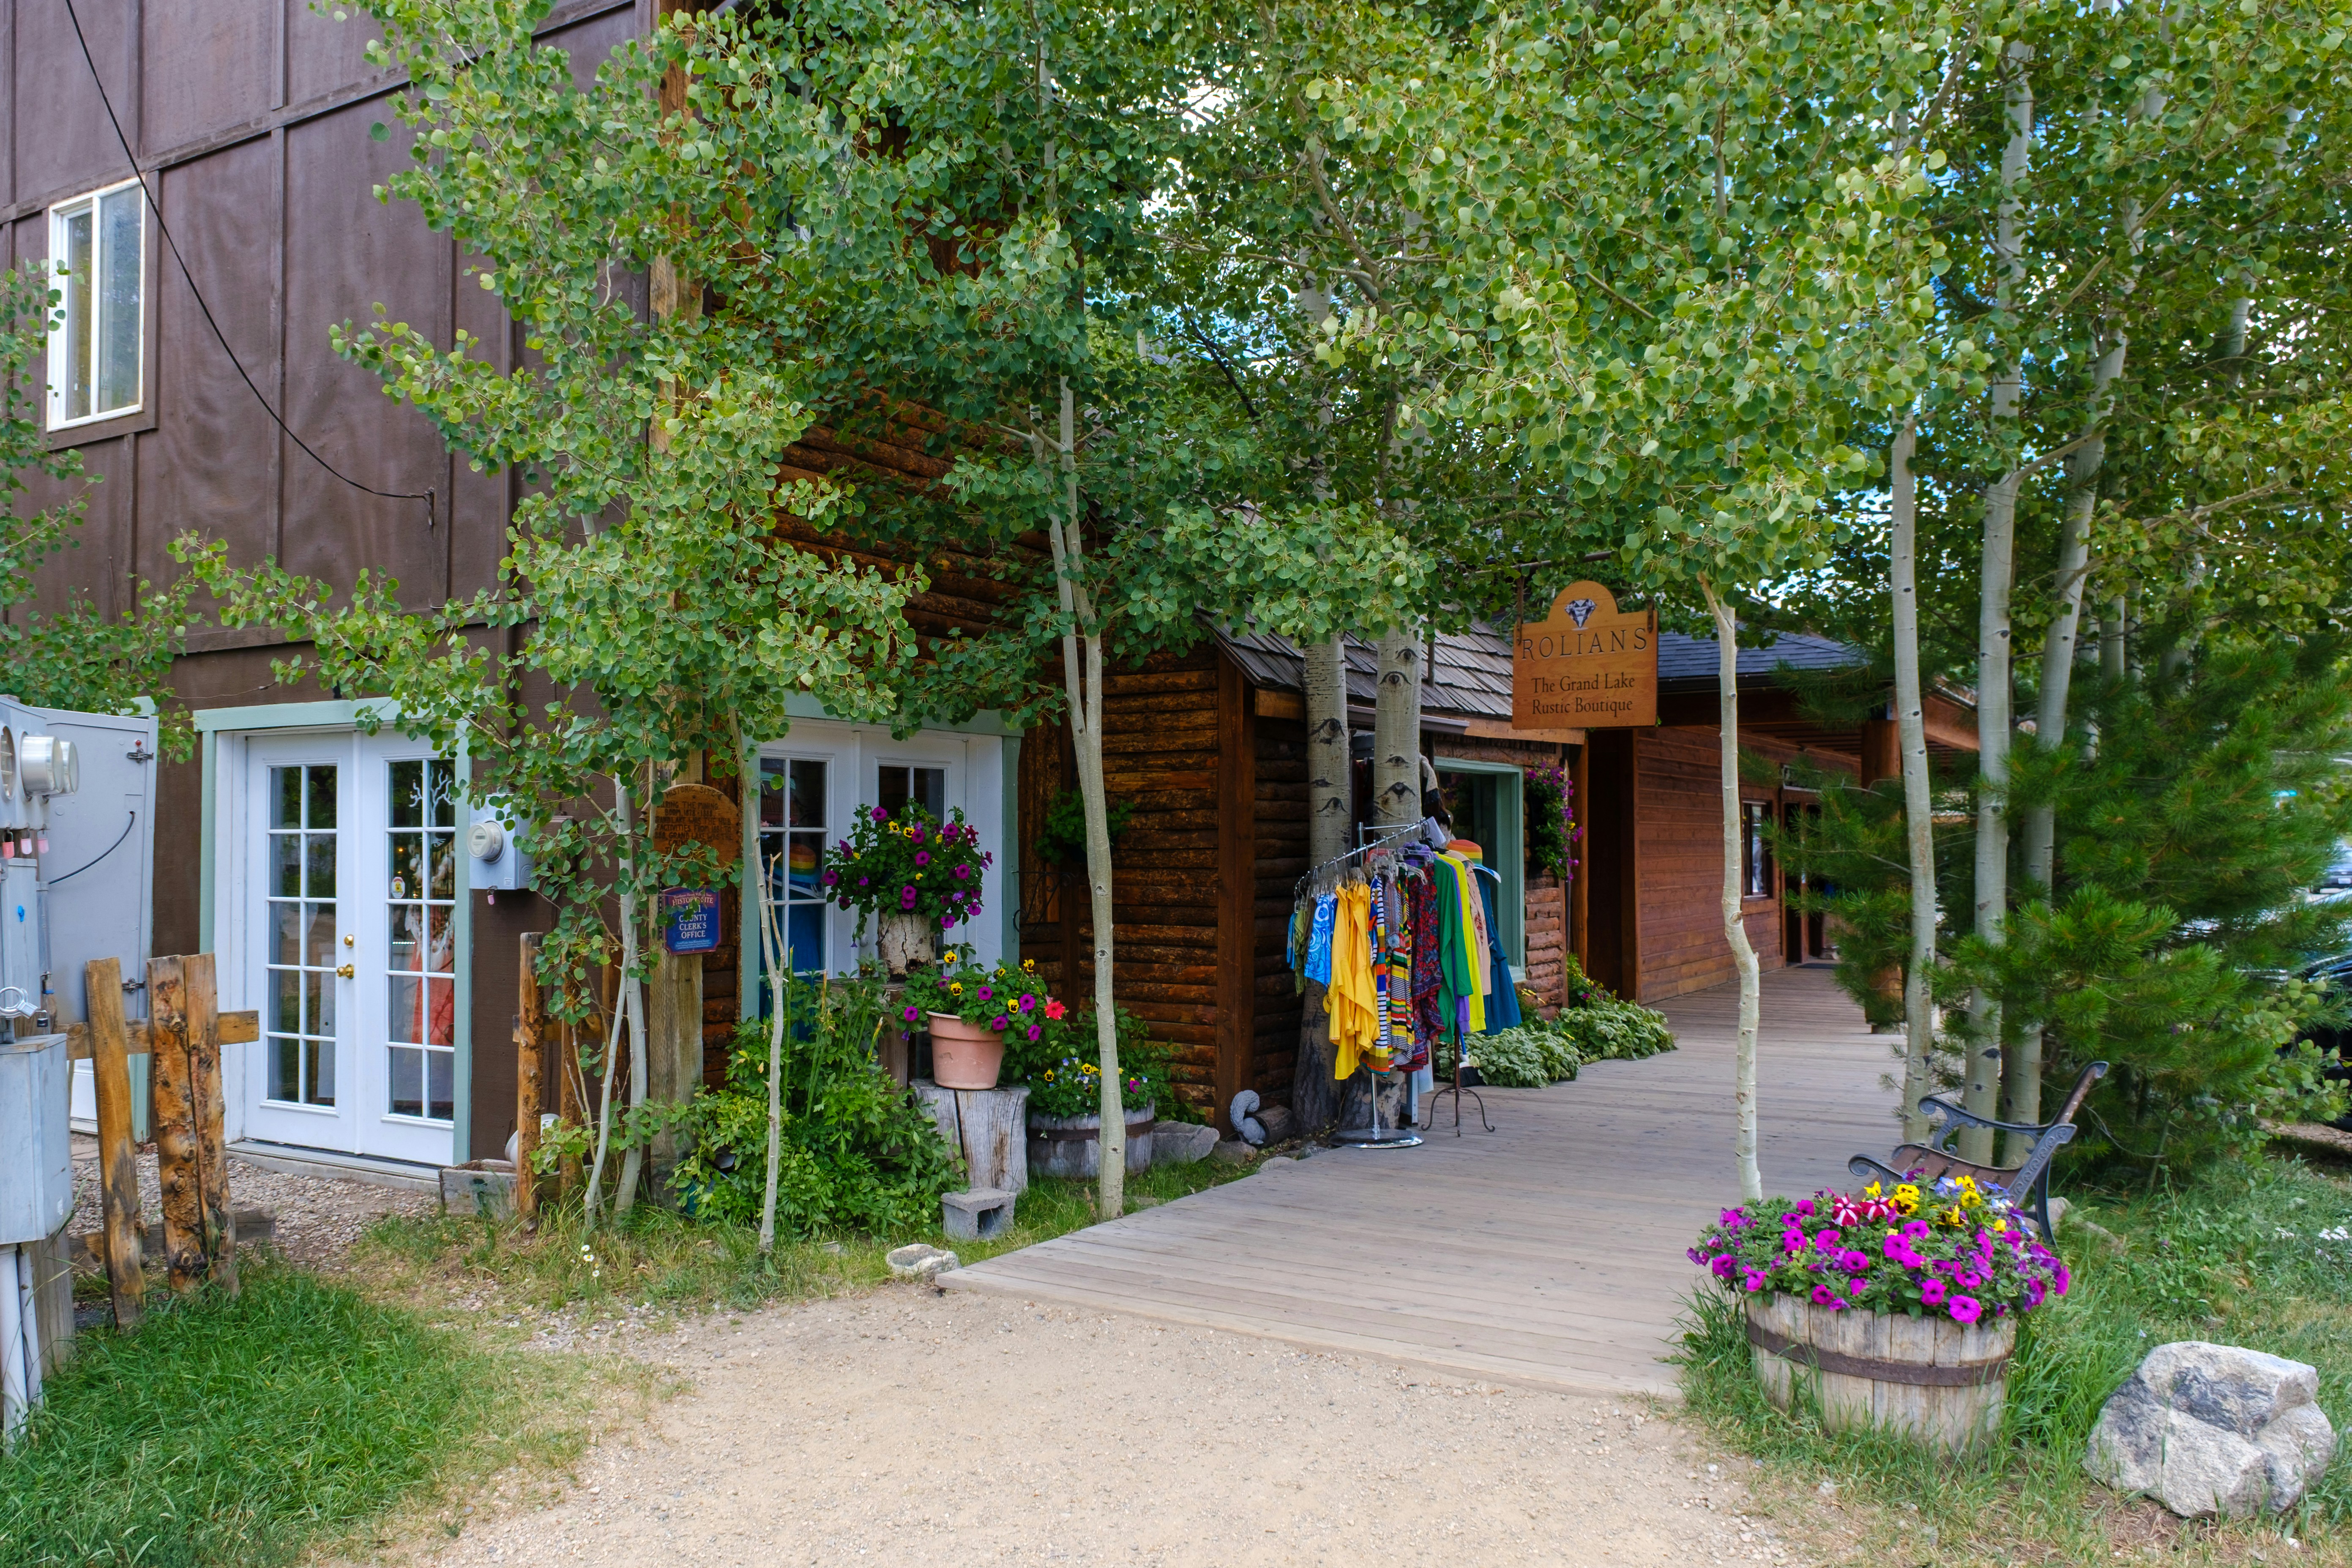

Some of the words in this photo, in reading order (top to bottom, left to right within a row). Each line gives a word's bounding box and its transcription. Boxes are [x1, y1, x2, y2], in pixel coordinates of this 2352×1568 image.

[1522, 628, 1647, 661] ROLIANS
[1531, 677, 1555, 693] The
[1560, 674, 1599, 691] Grand
[1605, 672, 1635, 689] Lake
[1532, 698, 1571, 715] Rustic
[1575, 696, 1633, 718] Boutique
[665, 785, 695, 798] HISTORIC
[679, 914, 707, 922] CUNTY
[679, 922, 707, 930] CLERK'S
[681, 930, 706, 939] OFFICE
